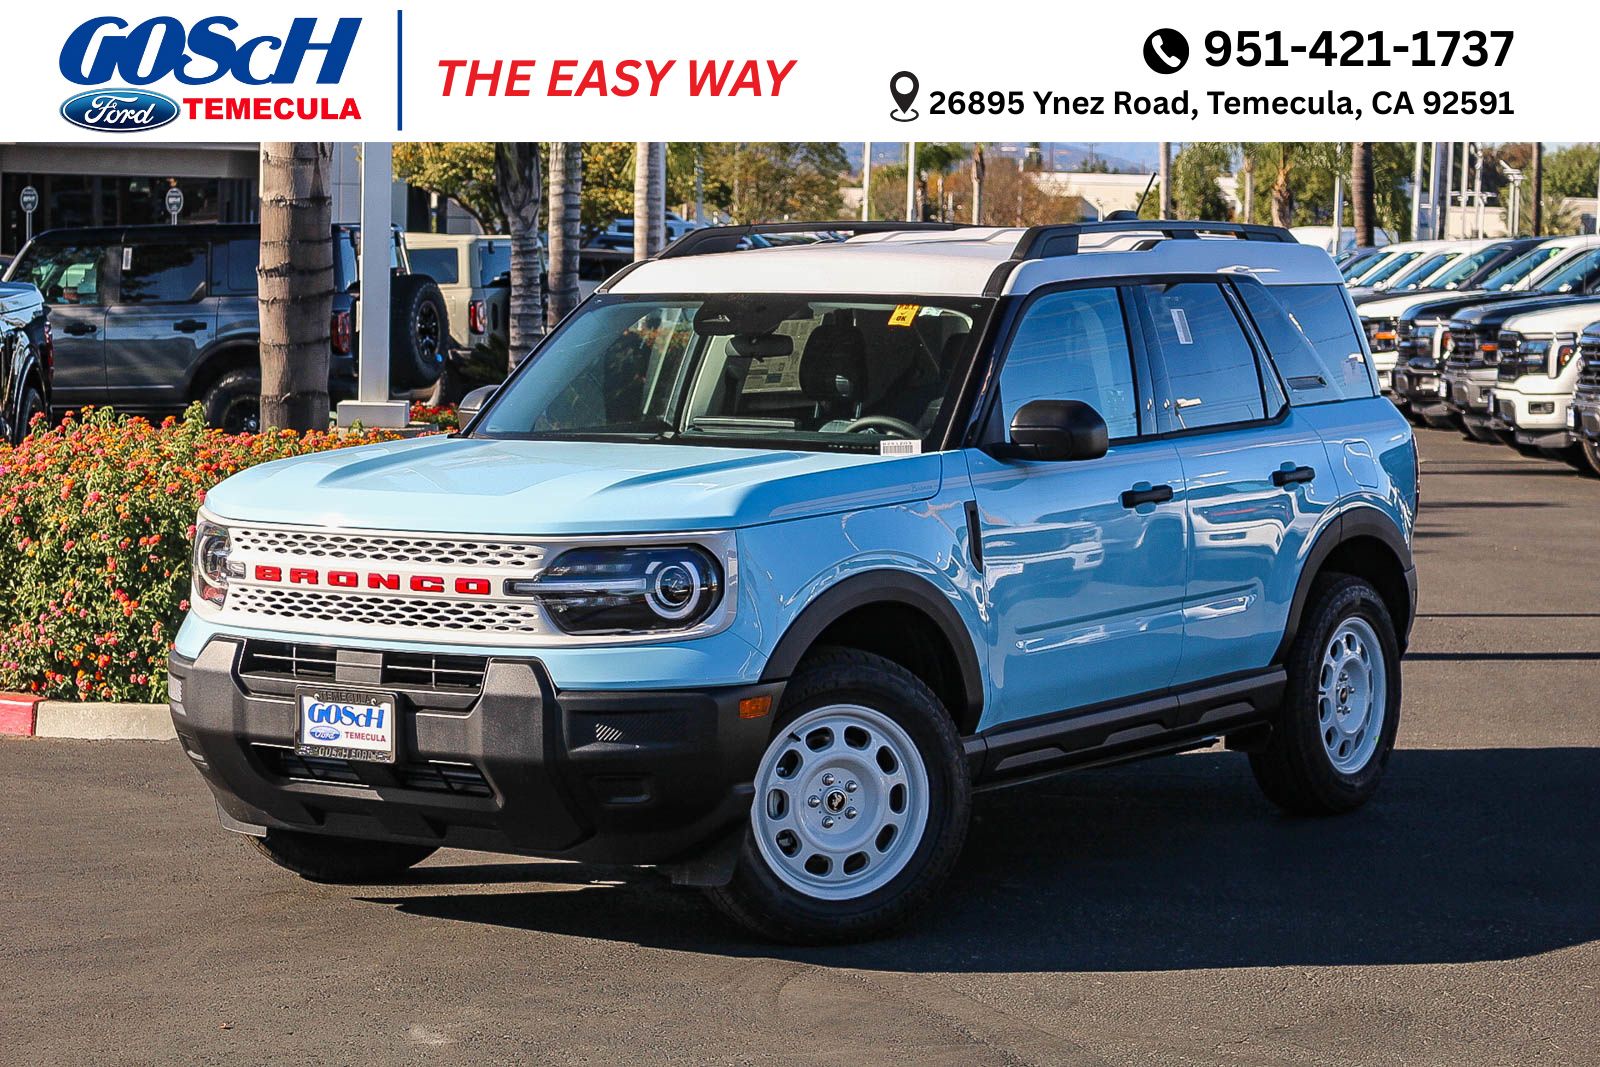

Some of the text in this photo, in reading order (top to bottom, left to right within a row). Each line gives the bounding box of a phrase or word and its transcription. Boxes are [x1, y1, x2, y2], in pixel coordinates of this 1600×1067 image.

[255, 565, 491, 595] BRONCO
[320, 690, 371, 704] TEMECULA
[345, 731, 387, 743] TEMECULA
